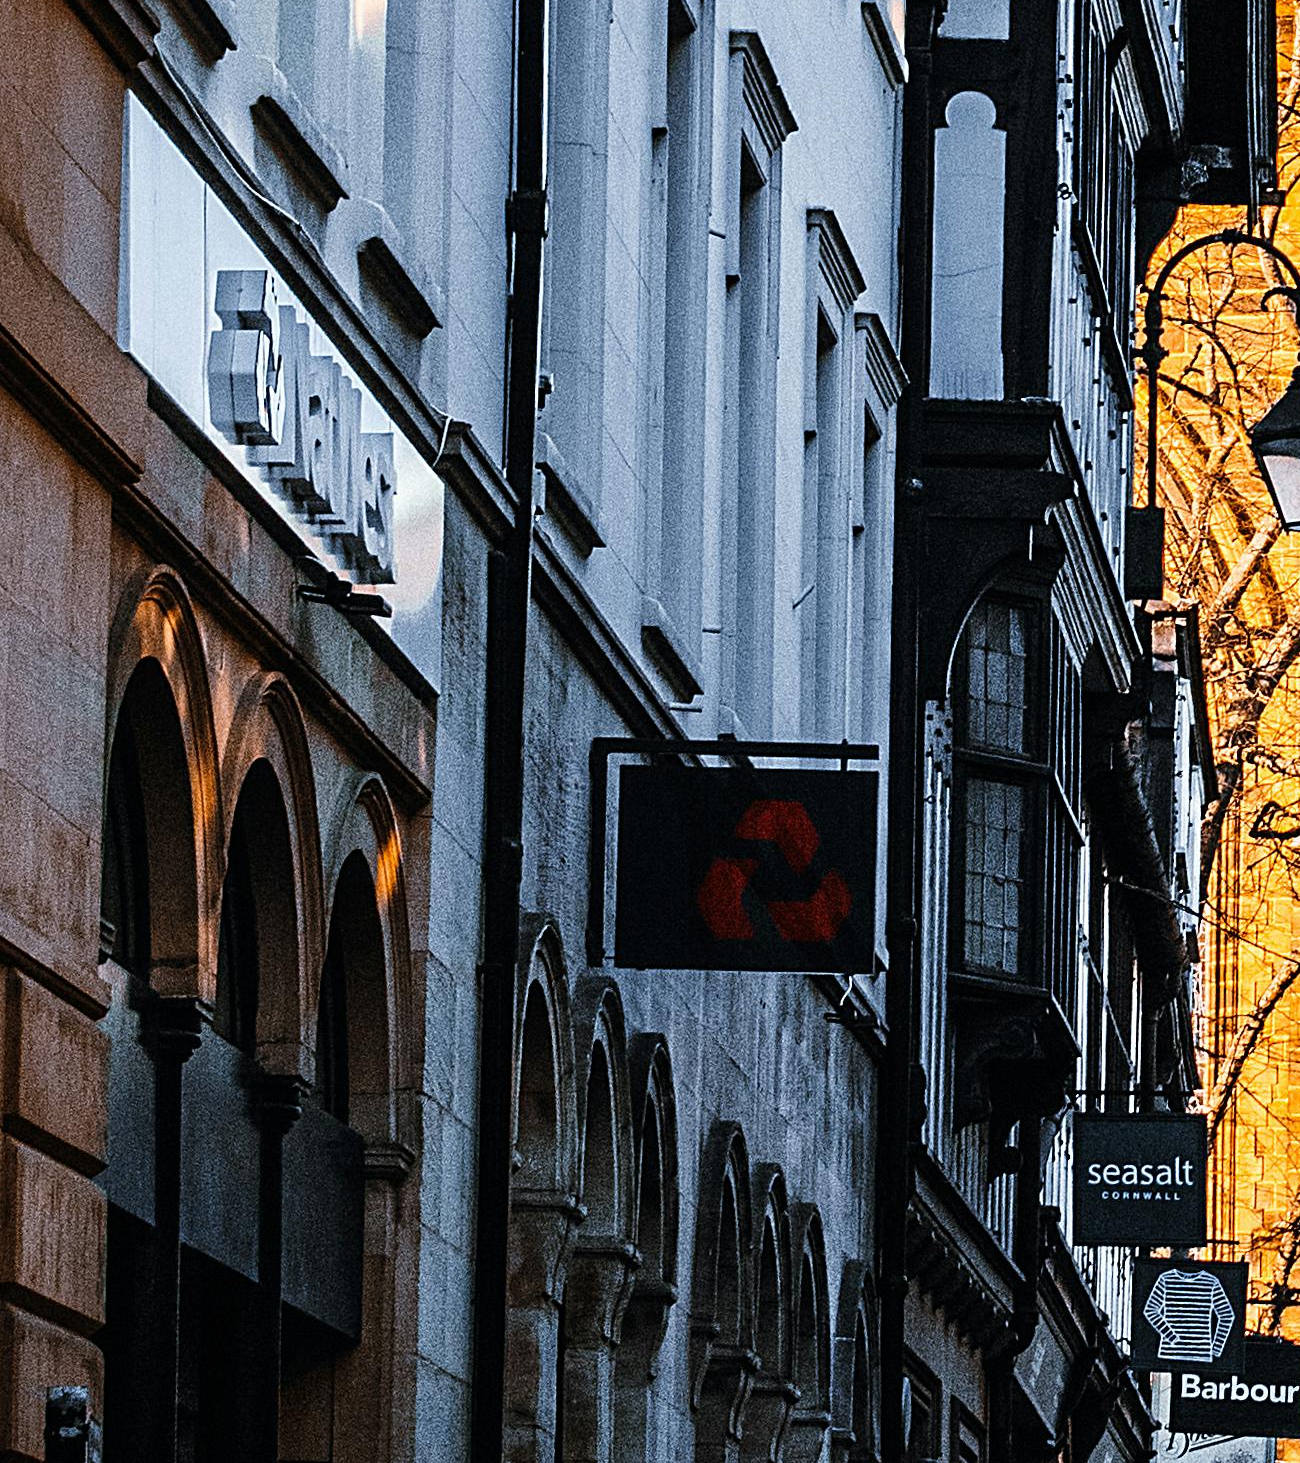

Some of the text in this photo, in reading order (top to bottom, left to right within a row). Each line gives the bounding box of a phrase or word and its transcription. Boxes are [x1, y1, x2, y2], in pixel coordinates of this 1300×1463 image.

[1087, 1156, 1194, 1186] seasalt
[1101, 1190, 1181, 1201] CORNWALL
[1180, 1373, 1300, 1404] Barbour
